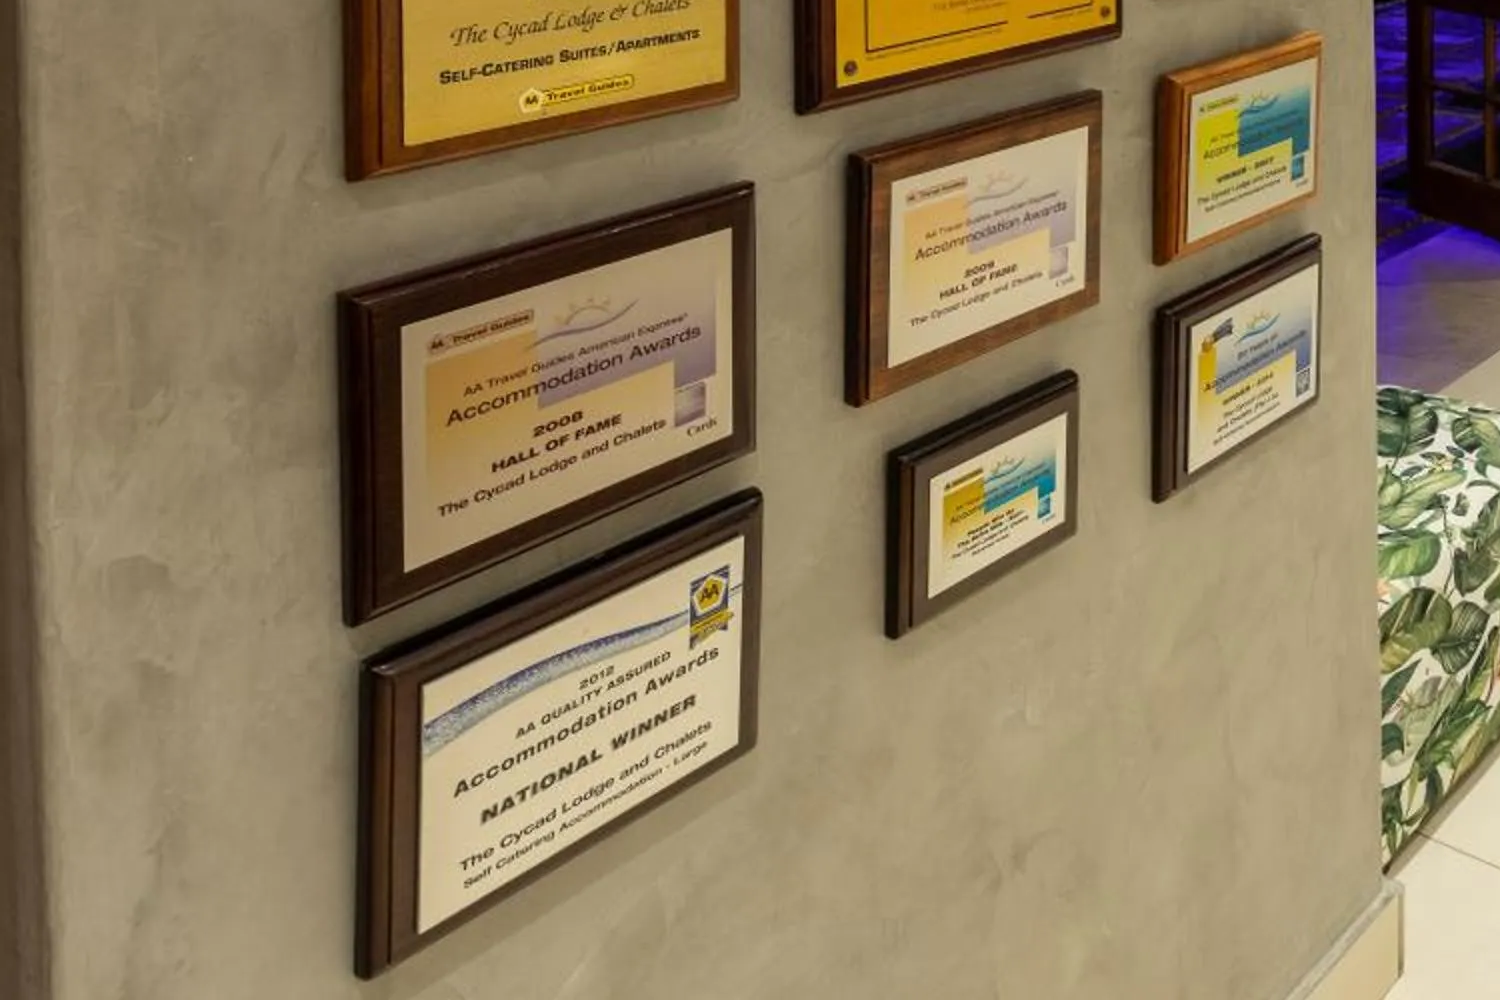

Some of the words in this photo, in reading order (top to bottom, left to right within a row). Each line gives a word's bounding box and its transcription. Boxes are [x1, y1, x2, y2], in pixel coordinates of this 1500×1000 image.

[450, 24, 487, 46] The
[493, 13, 549, 45] Cycad
[552, 6, 605, 32] Lodge
[446, 354, 623, 427] Accommodation
[629, 325, 701, 361] Awards
[452, 325, 488, 345] Travel
[463, 382, 484, 397] AA
[488, 368, 528, 390] Travel
[438, 498, 469, 517] The
[473, 473, 526, 502] Cycad
[529, 454, 578, 482] Lodge
[581, 439, 610, 461] and
[613, 418, 666, 447] Chalets
[491, 447, 540, 473] HALL
[545, 434, 571, 452] OF
[575, 413, 622, 441] FAME
[454, 692, 638, 798] Accommodation
[645, 648, 719, 695] Awards
[515, 722, 537, 739] AA
[541, 688, 603, 726] QUALITY
[606, 651, 671, 692] ASSURED
[579, 665, 615, 691] 2012
[459, 847, 495, 871] The
[500, 808, 557, 848] Cycad
[561, 777, 615, 814] Lodge
[619, 755, 650, 781] and
[653, 720, 712, 759] Chalets
[480, 749, 603, 825] NATIONAL
[611, 694, 697, 751] WINNER
[463, 866, 492, 889] Self
[558, 768, 663, 833] Accommodation
